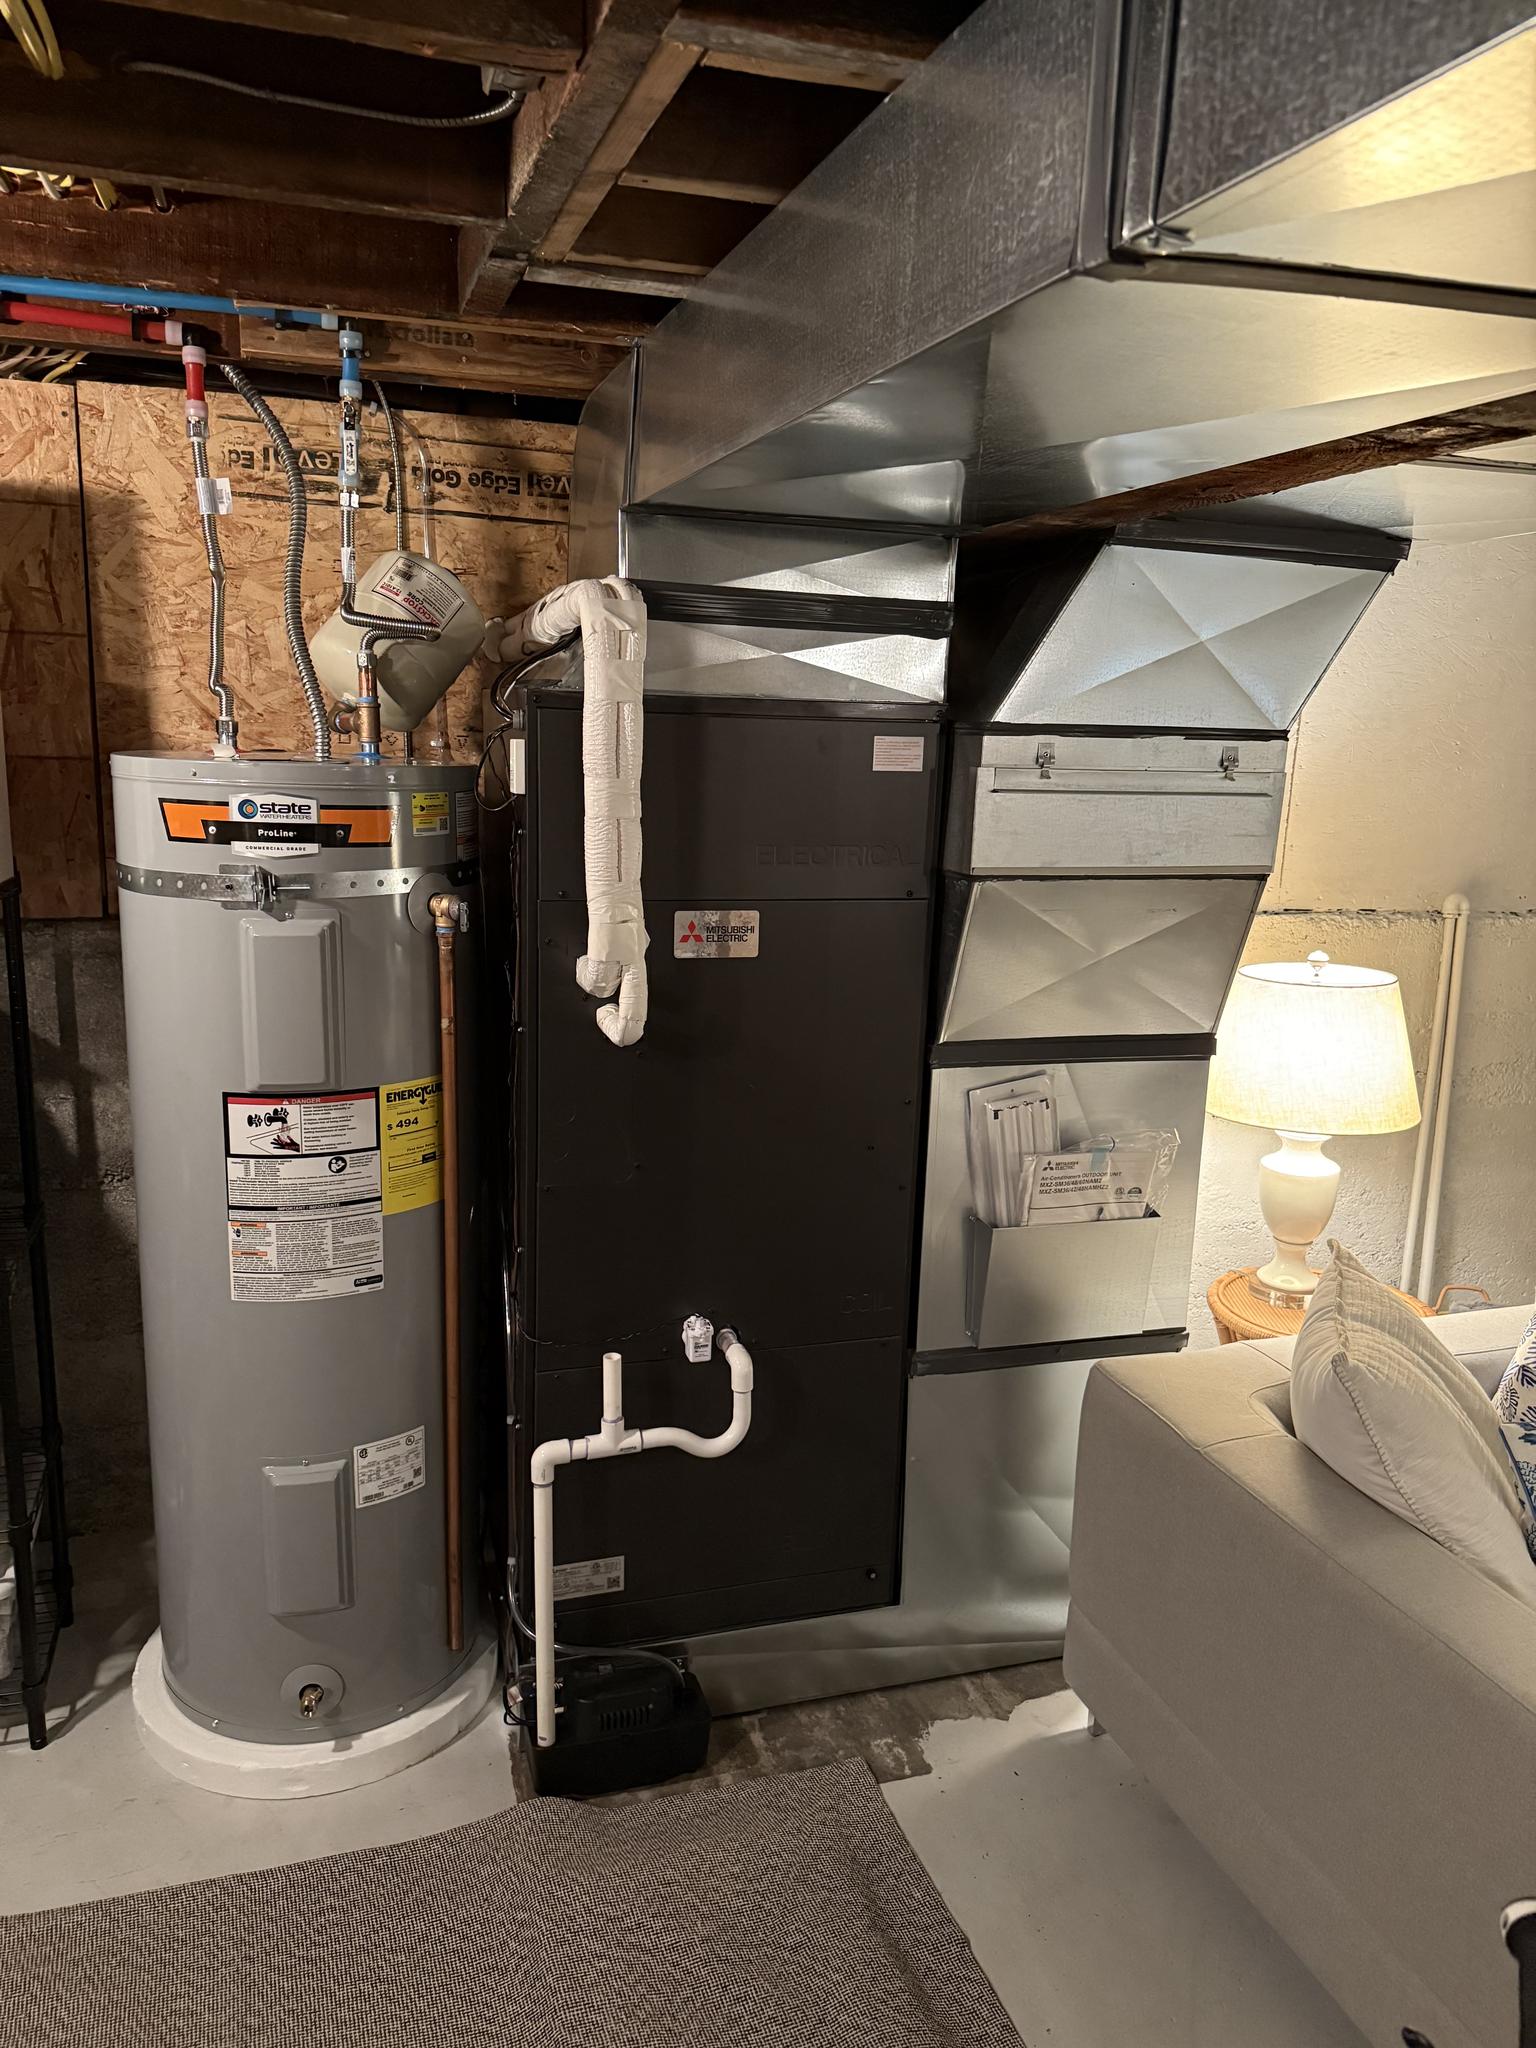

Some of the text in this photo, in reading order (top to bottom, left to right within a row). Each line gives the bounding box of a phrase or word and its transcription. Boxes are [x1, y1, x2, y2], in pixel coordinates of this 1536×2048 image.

[468, 471, 520, 496] Edge
[259, 802, 312, 814] state
[755, 844, 921, 867] ELECTRICAL
[706, 926, 755, 934] MITSUBISHI
[706, 934, 748, 943] ELECTRIC
[291, 1097, 321, 1105] DANGER
[396, 1116, 419, 1129] 494
